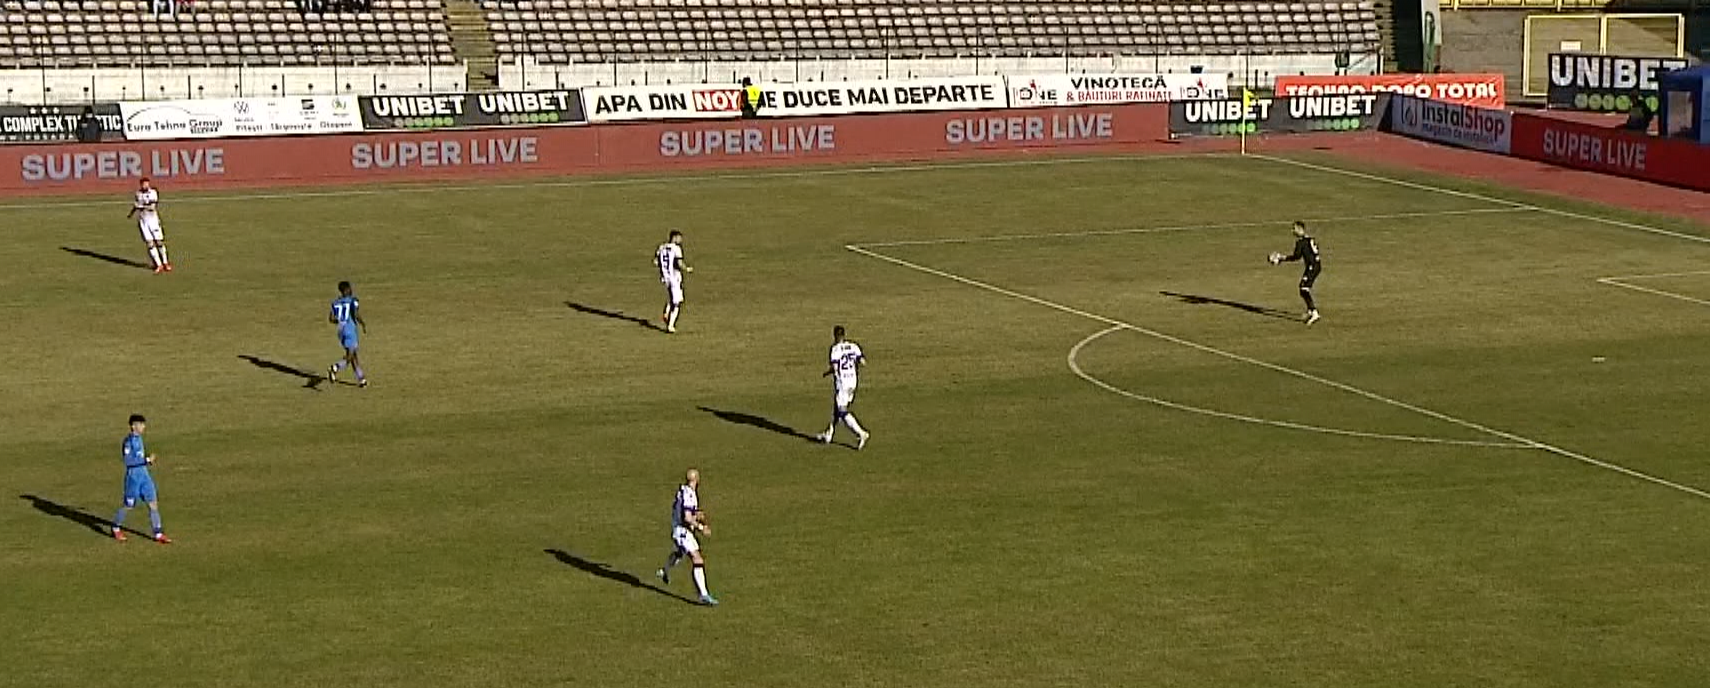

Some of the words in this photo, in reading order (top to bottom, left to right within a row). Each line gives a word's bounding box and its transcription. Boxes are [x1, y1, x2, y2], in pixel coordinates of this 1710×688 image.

[1552, 55, 1686, 90] UNIBE
[479, 91, 569, 113] UNIBET
[596, 95, 642, 114] APA
[649, 93, 687, 110] DIN
[784, 88, 842, 108] DUCE
[847, 87, 889, 106] MAI
[894, 84, 995, 104] DEPARTE
[1436, 83, 1497, 98] TOTAL
[372, 95, 465, 116] UNIBET
[1185, 99, 1272, 122] UNIBET
[1289, 95, 1376, 118] UNIBET
[3, 116, 63, 132] COMPLEX
[945, 116, 1044, 144] SUPER
[1053, 113, 1113, 139] LIVE
[1422, 100, 1504, 142] InstalShop
[352, 140, 461, 169] SUPER
[470, 137, 537, 164] LIVE
[660, 128, 763, 156] SUPER
[771, 124, 835, 151] LIVE
[1543, 128, 1601, 162] SUPER
[1607, 139, 1646, 170] LIVE
[22, 151, 142, 181] SUPER
[151, 148, 225, 177] LIVE
[334, 303, 350, 320] 77
[841, 353, 856, 370] 25
